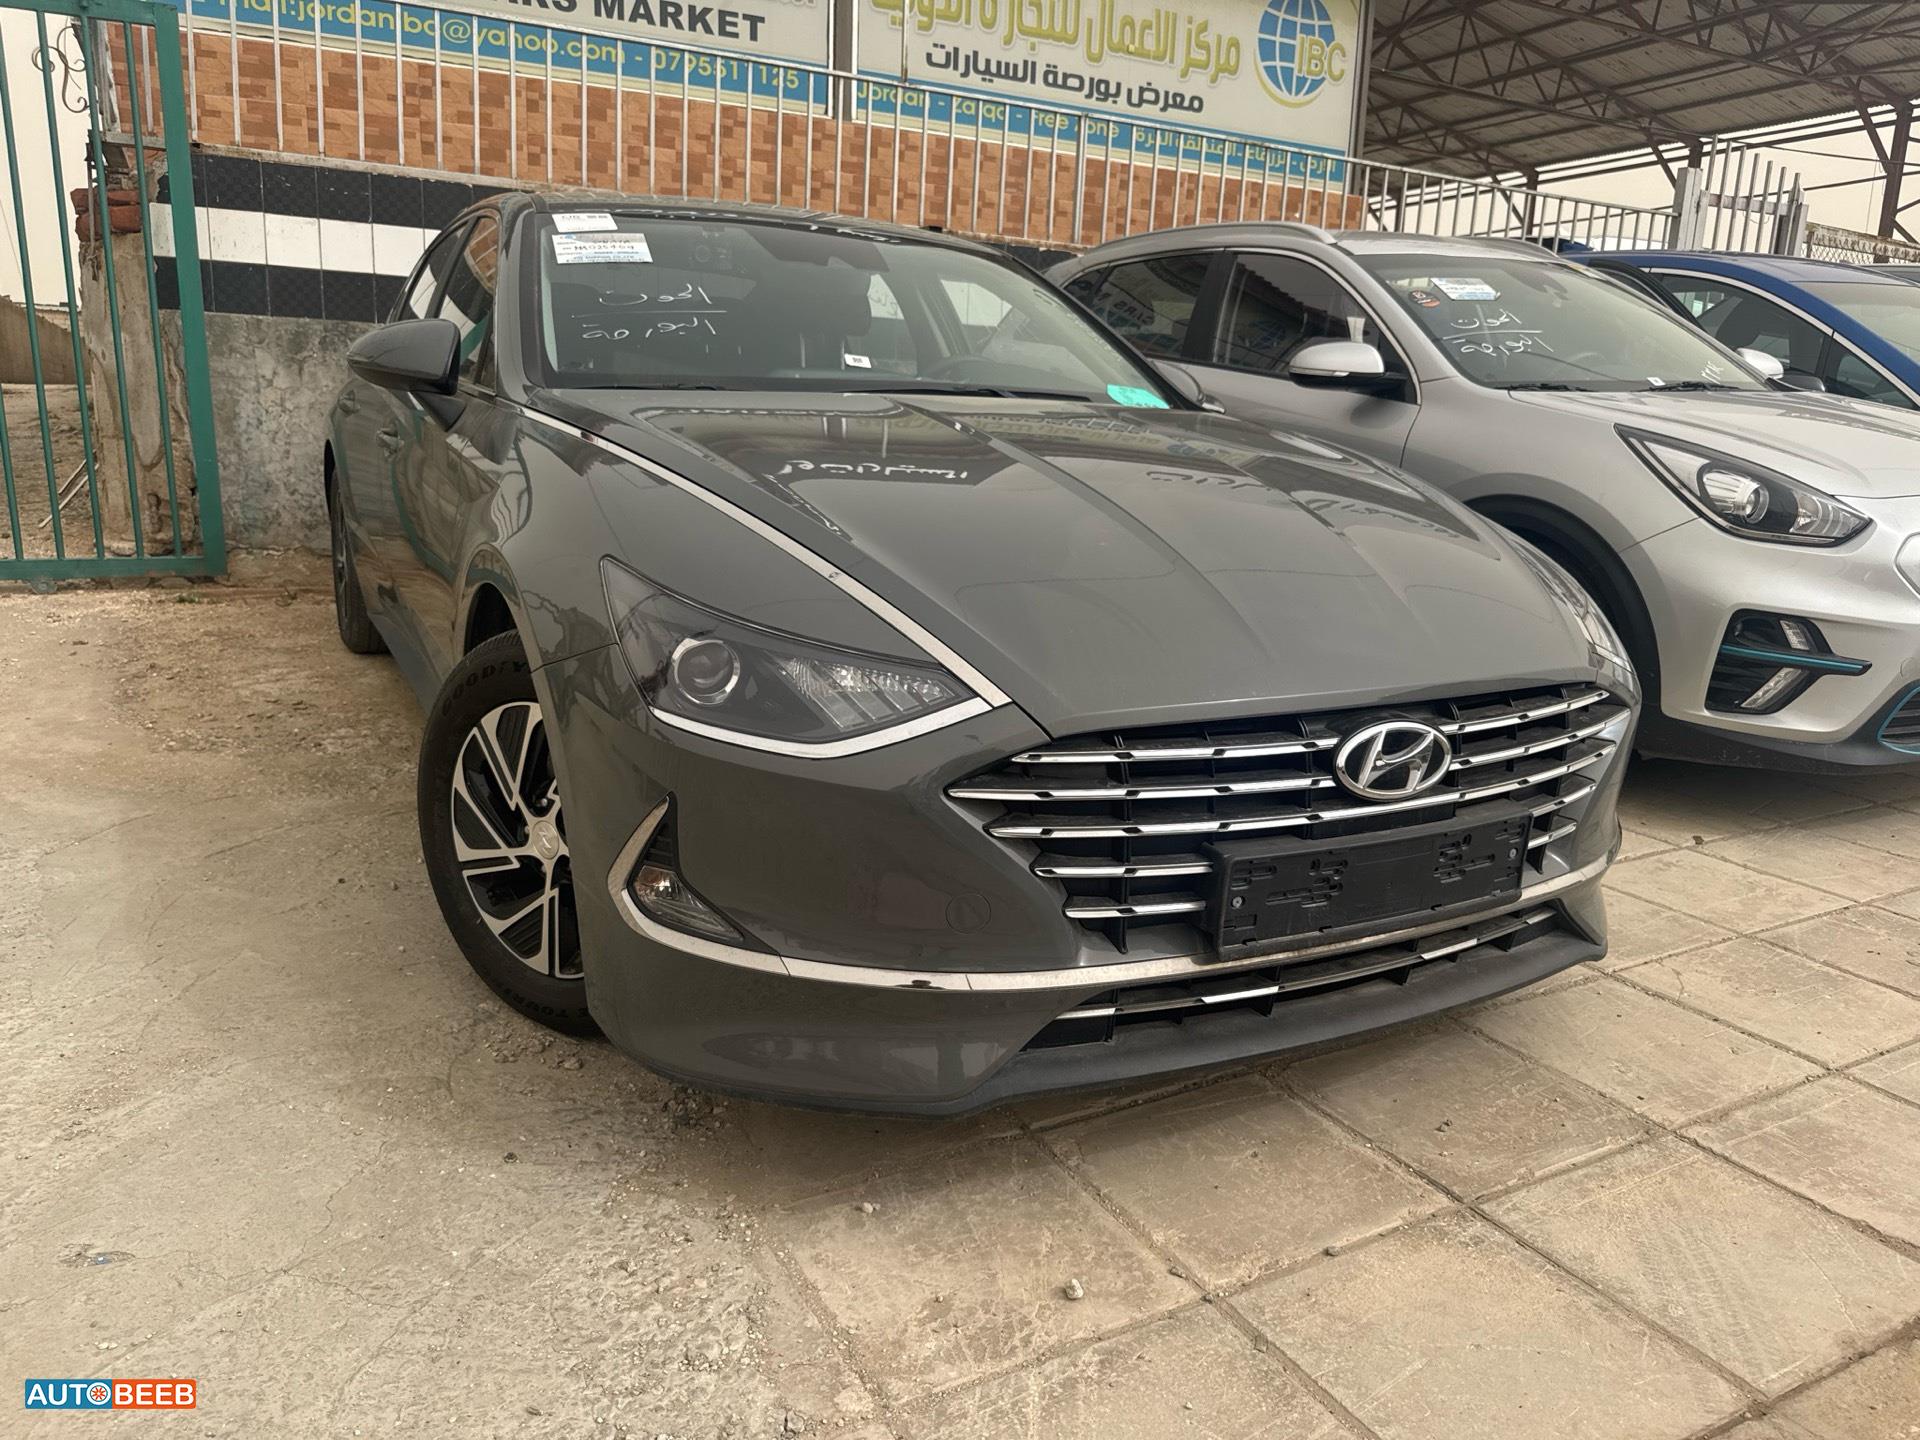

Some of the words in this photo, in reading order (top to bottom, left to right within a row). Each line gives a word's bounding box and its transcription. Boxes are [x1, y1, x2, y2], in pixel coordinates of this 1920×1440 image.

[594, 0, 765, 42] MARKET
[925, 42, 1037, 85] السيارات
[1180, 15, 1240, 84] مركز
[1297, 35, 1346, 82] IBC
[1042, 63, 1122, 101] بورصة
[1126, 82, 1204, 113] معرض
